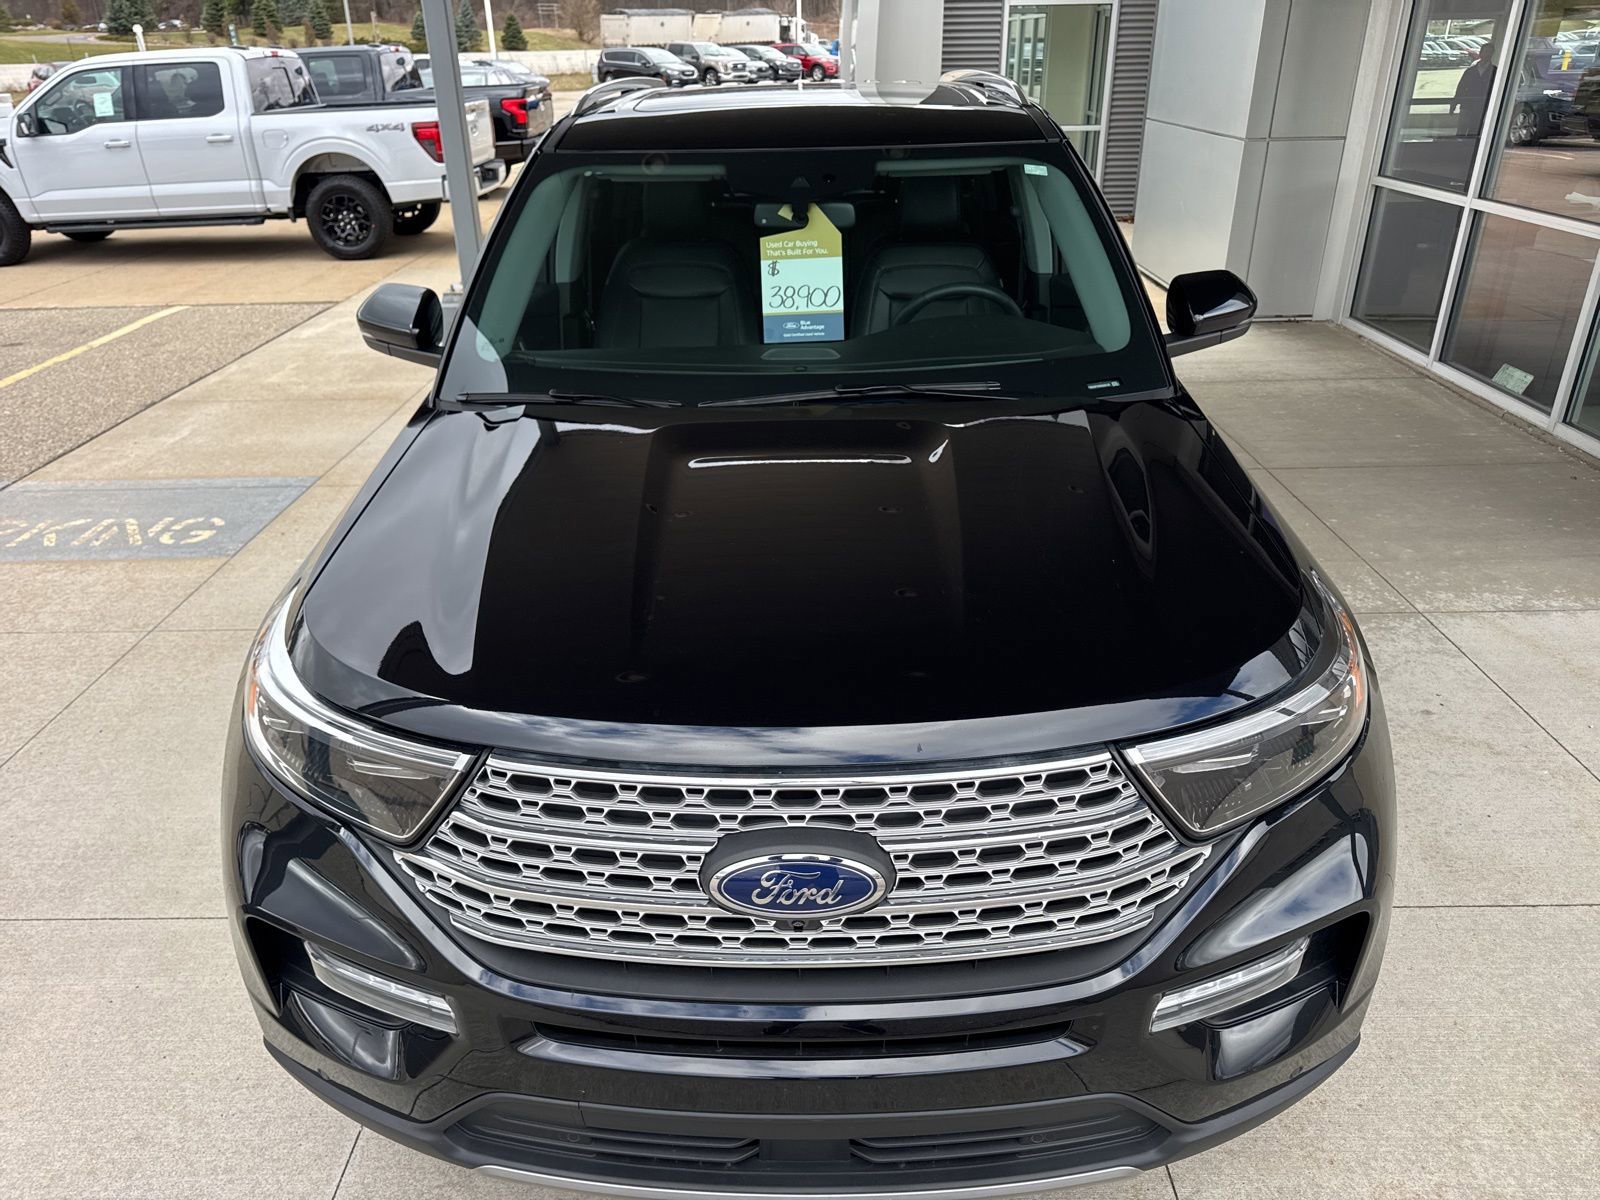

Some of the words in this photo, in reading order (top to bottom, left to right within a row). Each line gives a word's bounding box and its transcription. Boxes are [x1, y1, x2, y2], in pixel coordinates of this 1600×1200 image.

[787, 248, 802, 256] Built
[796, 240, 818, 248] Buying
[768, 260, 780, 277] $
[769, 284, 841, 311] 38,900
[751, 869, 844, 906] Ford
